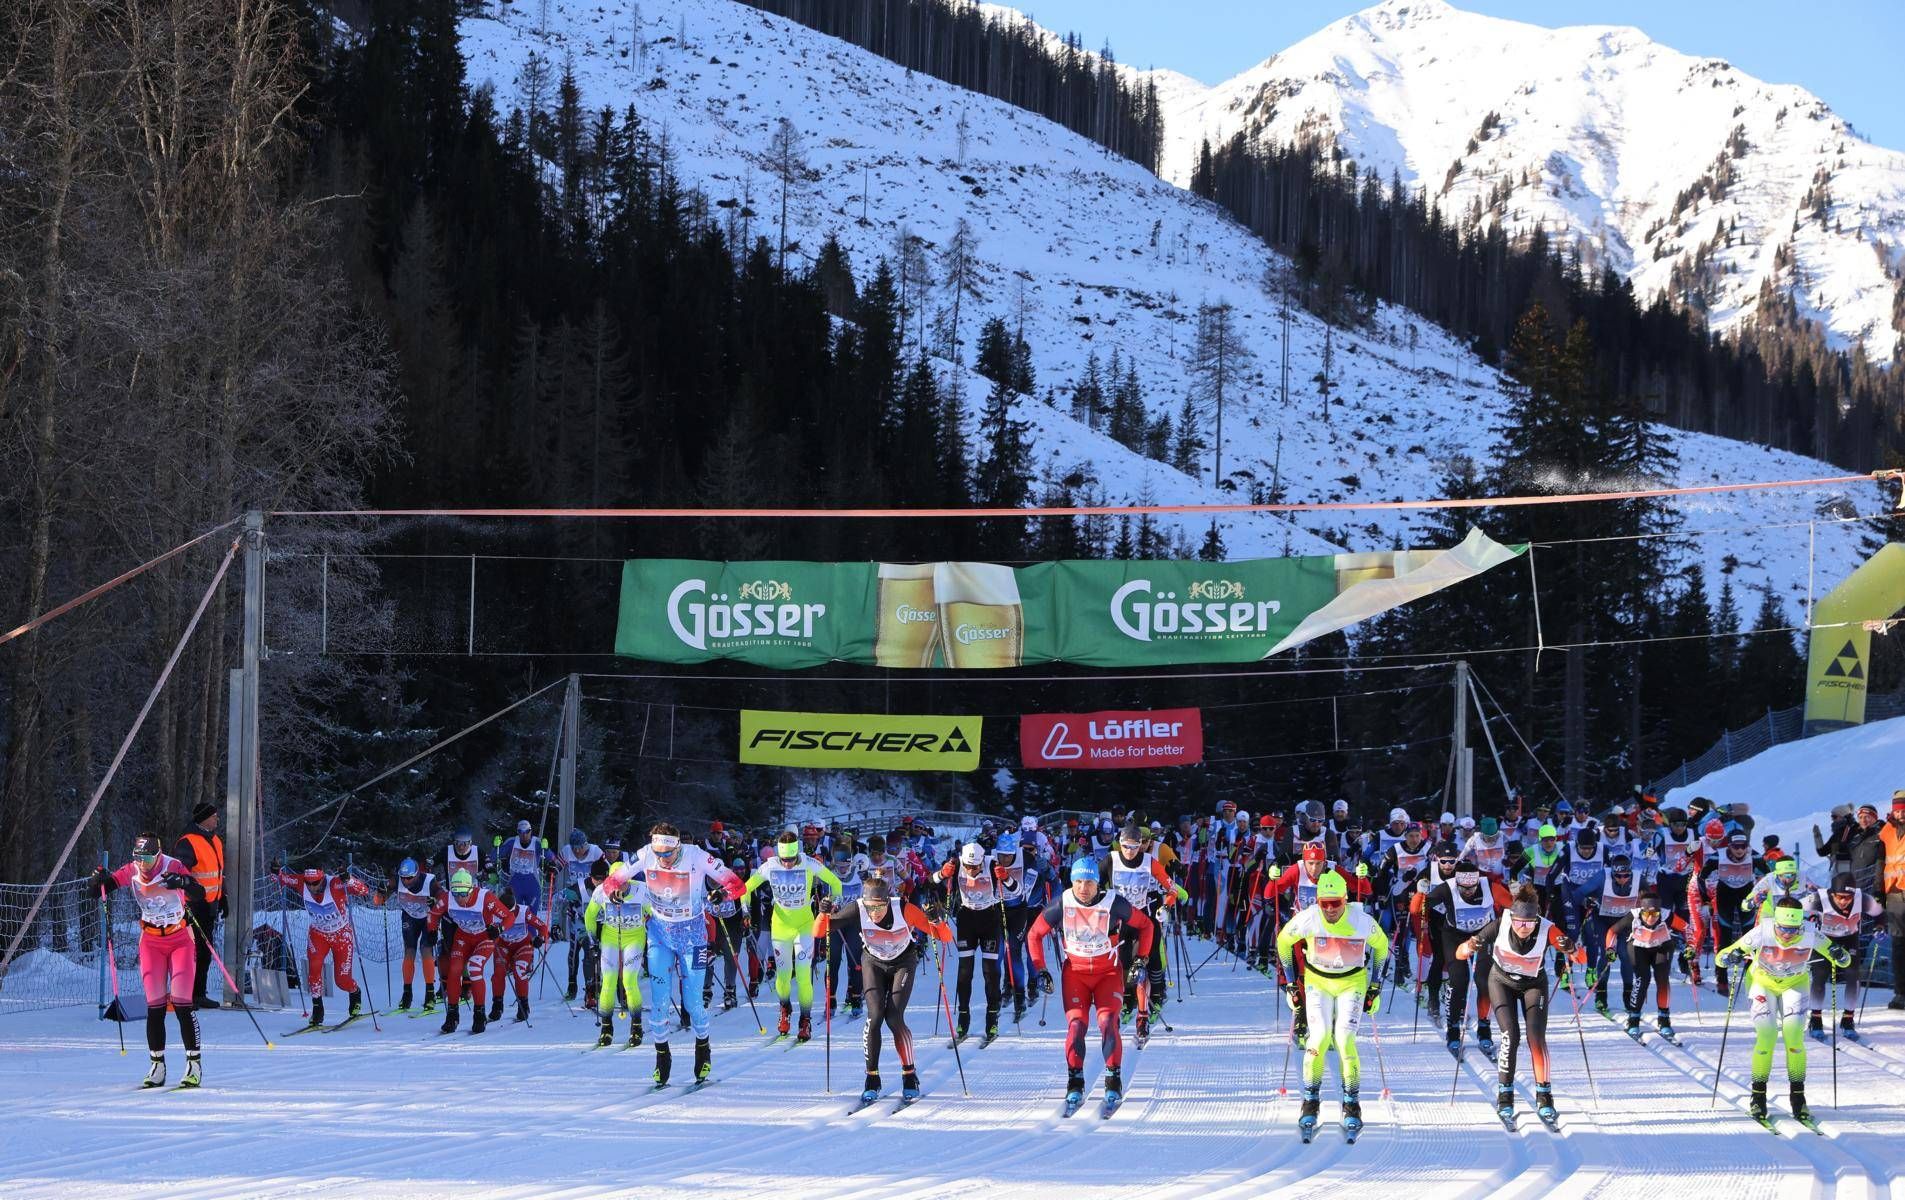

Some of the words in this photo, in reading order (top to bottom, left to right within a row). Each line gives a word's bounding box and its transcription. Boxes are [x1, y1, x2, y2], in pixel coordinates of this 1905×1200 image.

[667, 579, 826, 650] Gösser
[895, 604, 936, 624] Gösse
[1110, 579, 1281, 642] Gösser
[711, 639, 770, 648] BRAUTRADITION
[955, 623, 1010, 645] Gösser
[749, 729, 940, 753] FISCHER
[1090, 747, 1125, 758] Made
[1127, 745, 1146, 757] for
[1148, 744, 1185, 756] better
[663, 886, 672, 898] 8
[771, 883, 805, 893] 3002
[147, 895, 166, 907] 23
[1498, 1030, 1511, 1074] TERREX
